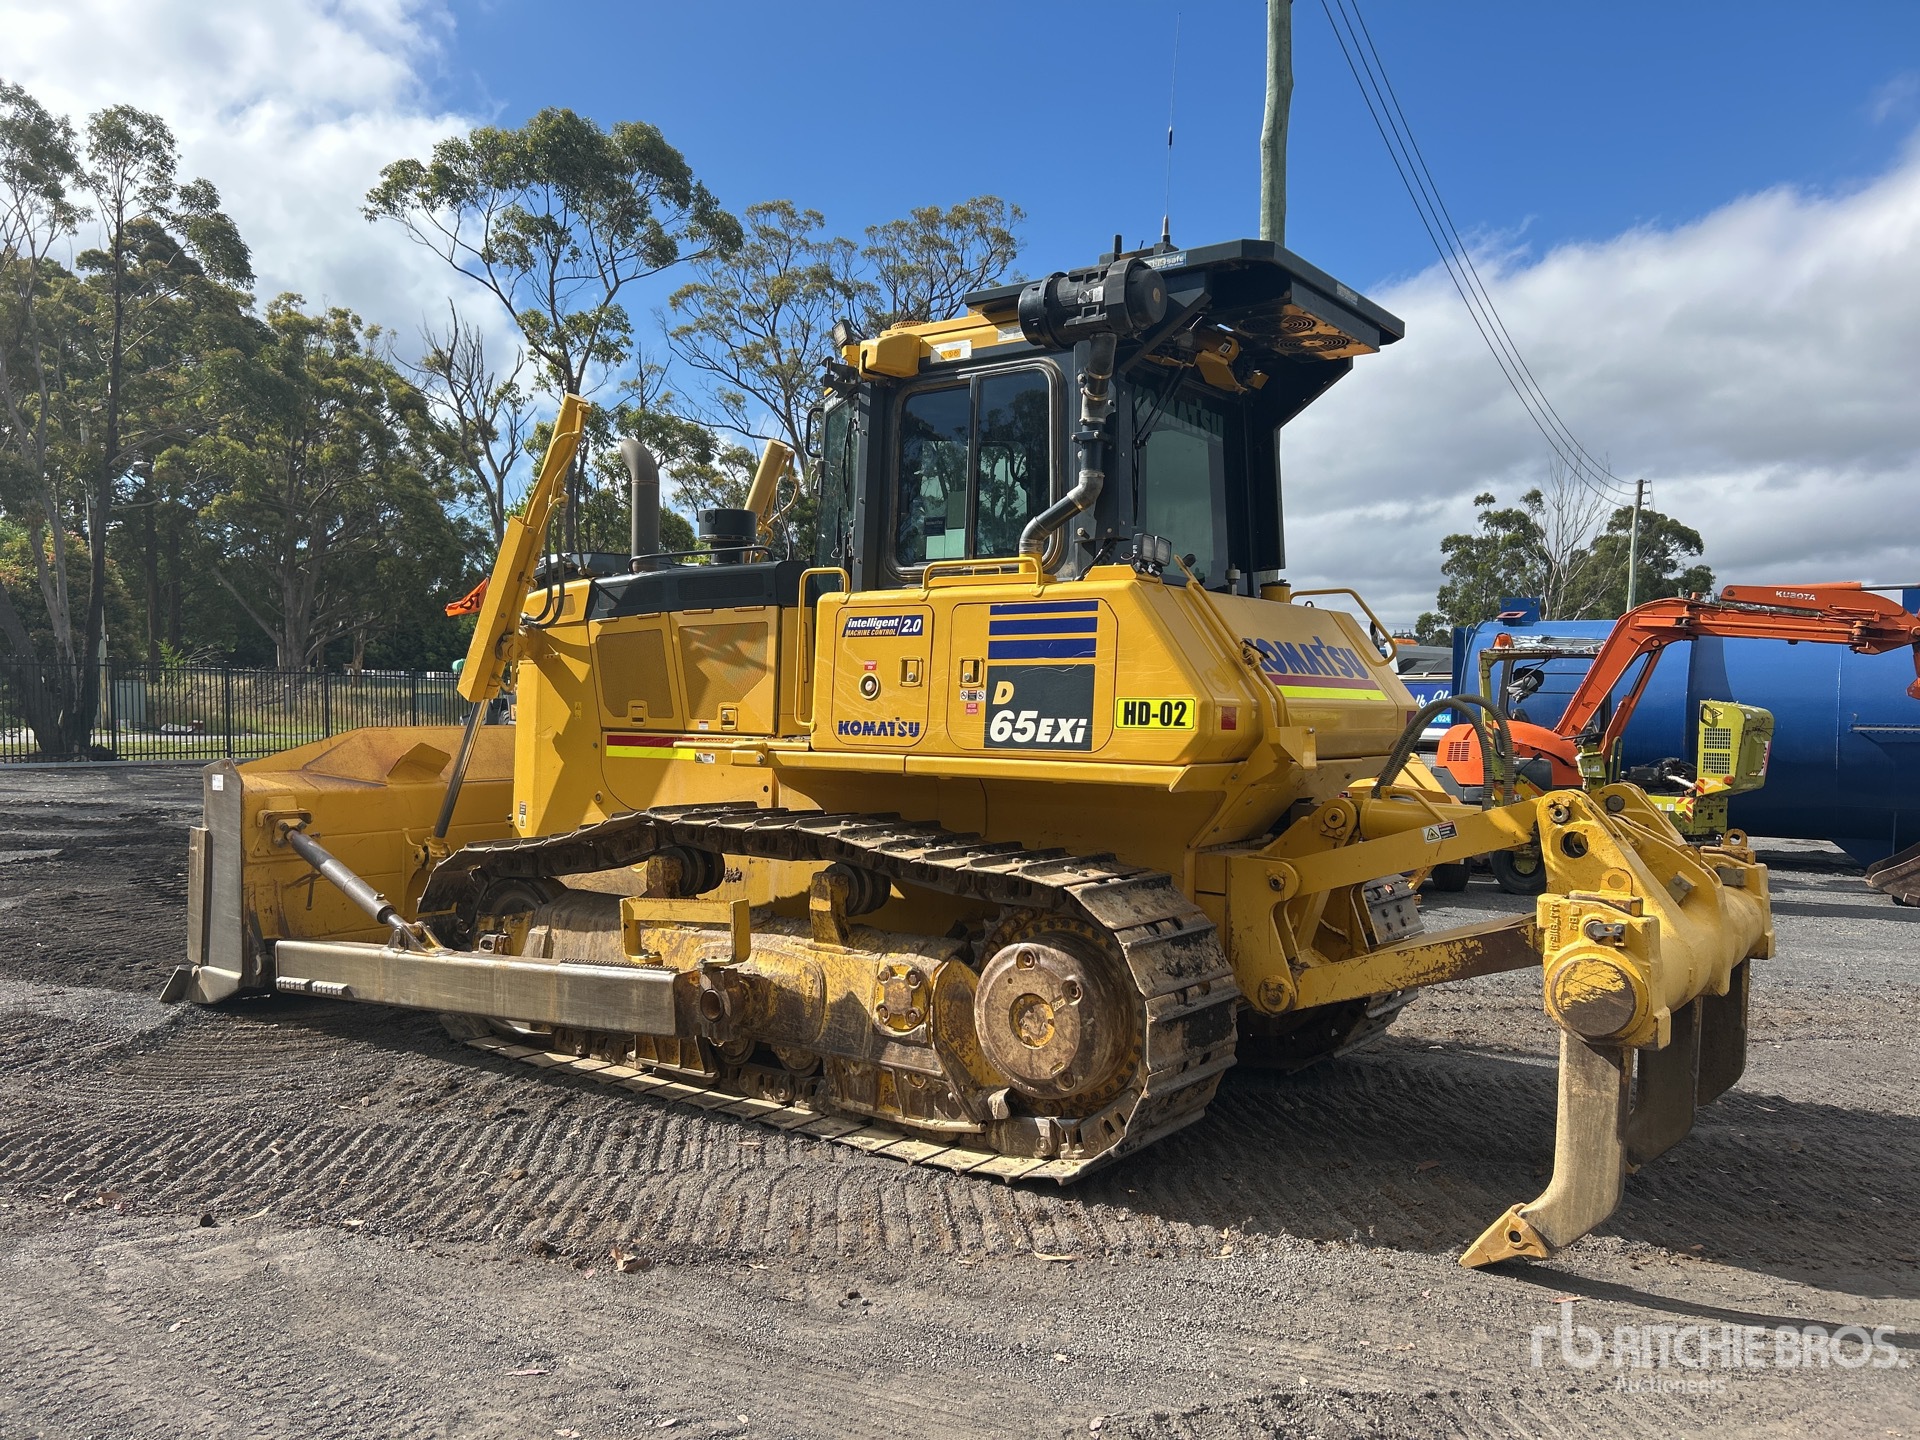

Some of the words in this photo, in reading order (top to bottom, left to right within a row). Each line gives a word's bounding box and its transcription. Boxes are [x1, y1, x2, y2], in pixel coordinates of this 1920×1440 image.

[1775, 590, 1816, 601] KUBOTA
[845, 629, 870, 637] MACHINE
[870, 628, 896, 636] CONTROL
[847, 617, 899, 629] intelligent
[901, 618, 922, 633] 2.0
[992, 681, 1015, 705] D
[1123, 701, 1187, 726] HD-02
[837, 717, 920, 738] KOMATSU
[989, 710, 1088, 743] 65EXi
